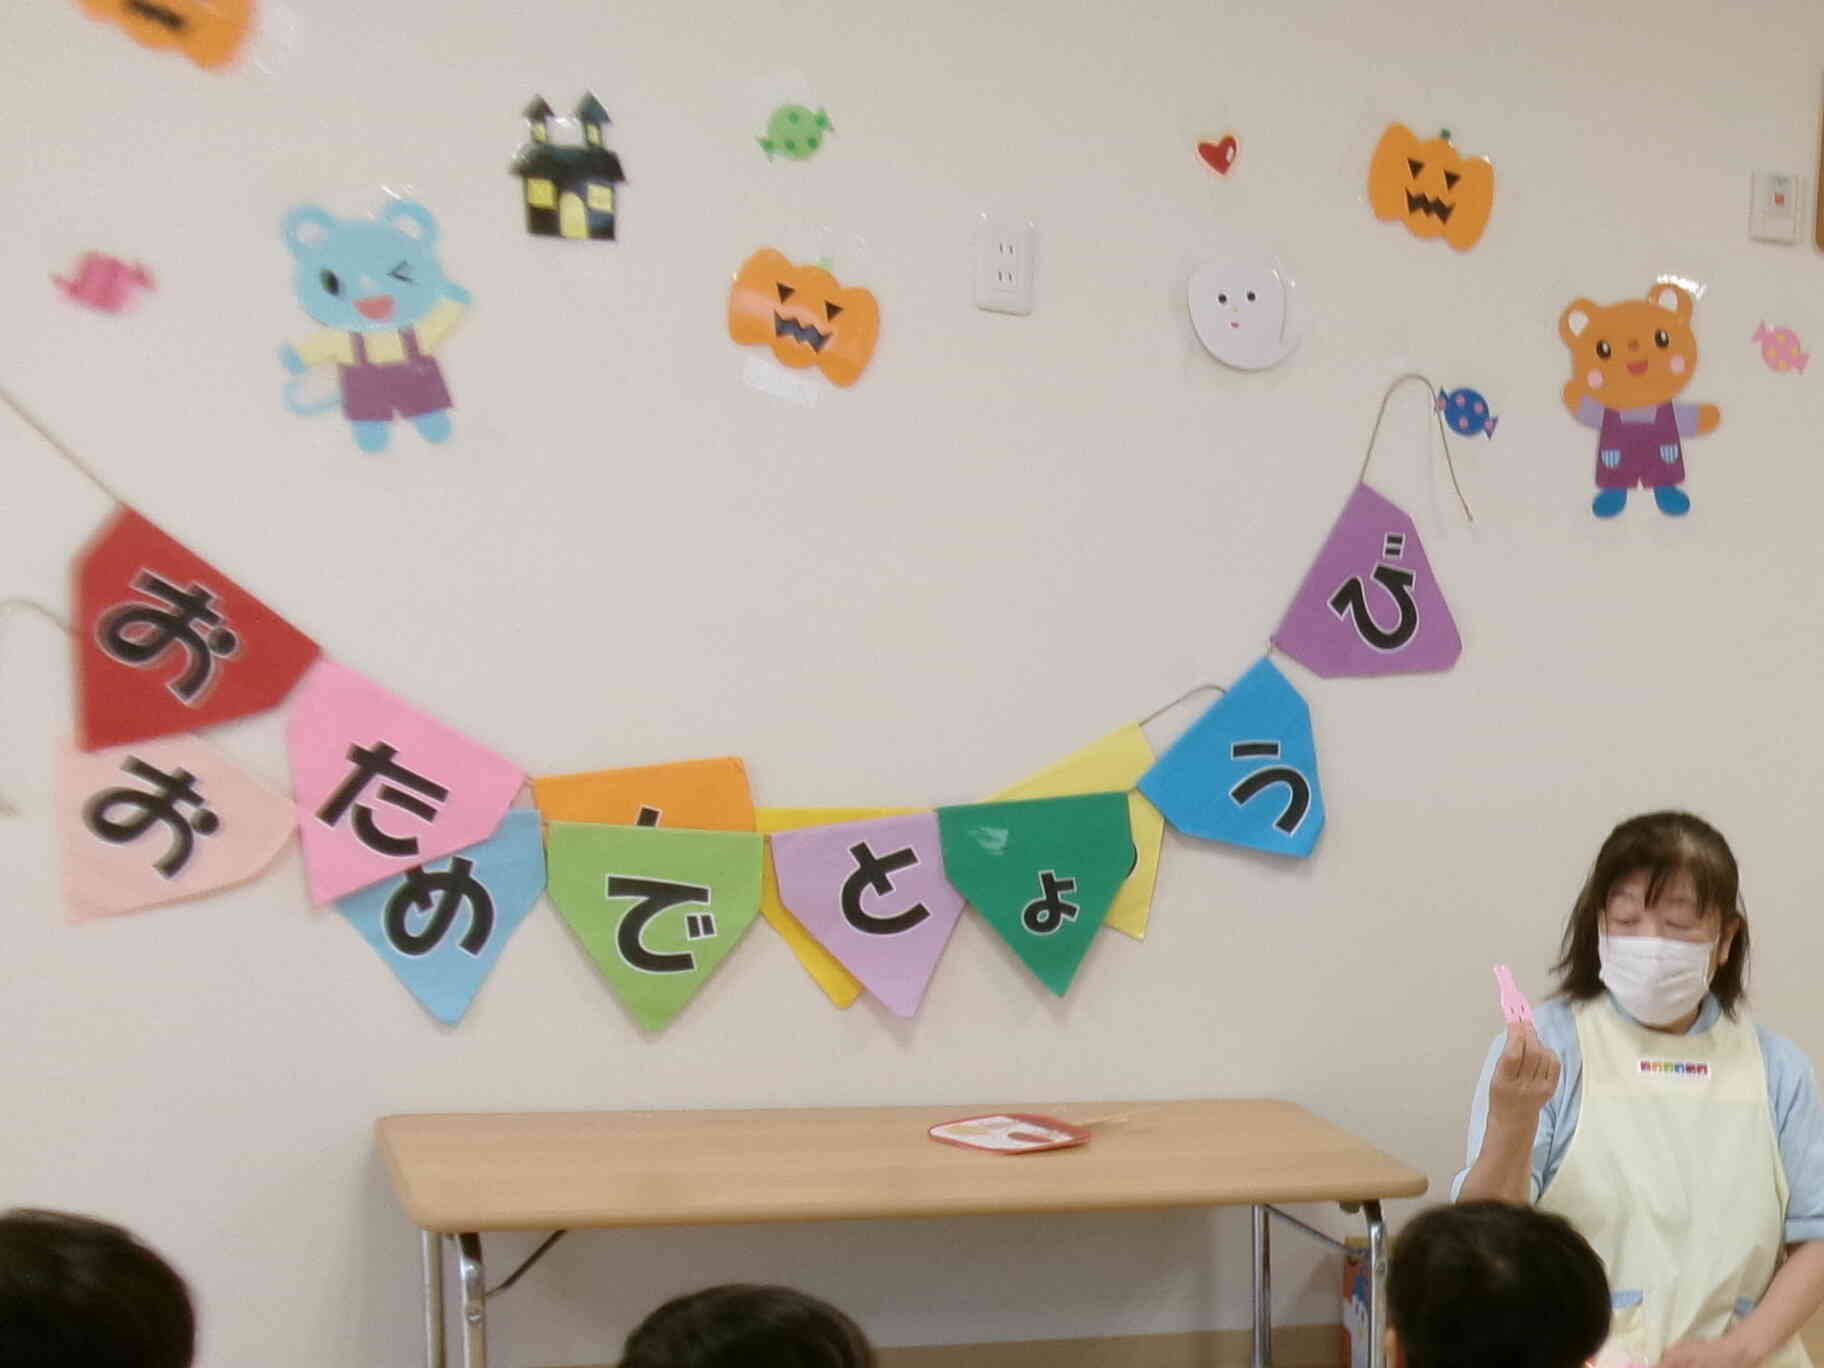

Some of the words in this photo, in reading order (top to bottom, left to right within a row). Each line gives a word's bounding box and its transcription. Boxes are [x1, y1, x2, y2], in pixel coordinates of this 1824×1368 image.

[97, 567, 238, 705] お
[314, 740, 450, 858] た
[1229, 740, 1312, 838] う
[1328, 532, 1419, 652] び
[81, 754, 221, 880] お
[383, 855, 495, 958] め
[604, 873, 716, 973] で
[839, 839, 932, 936] と
